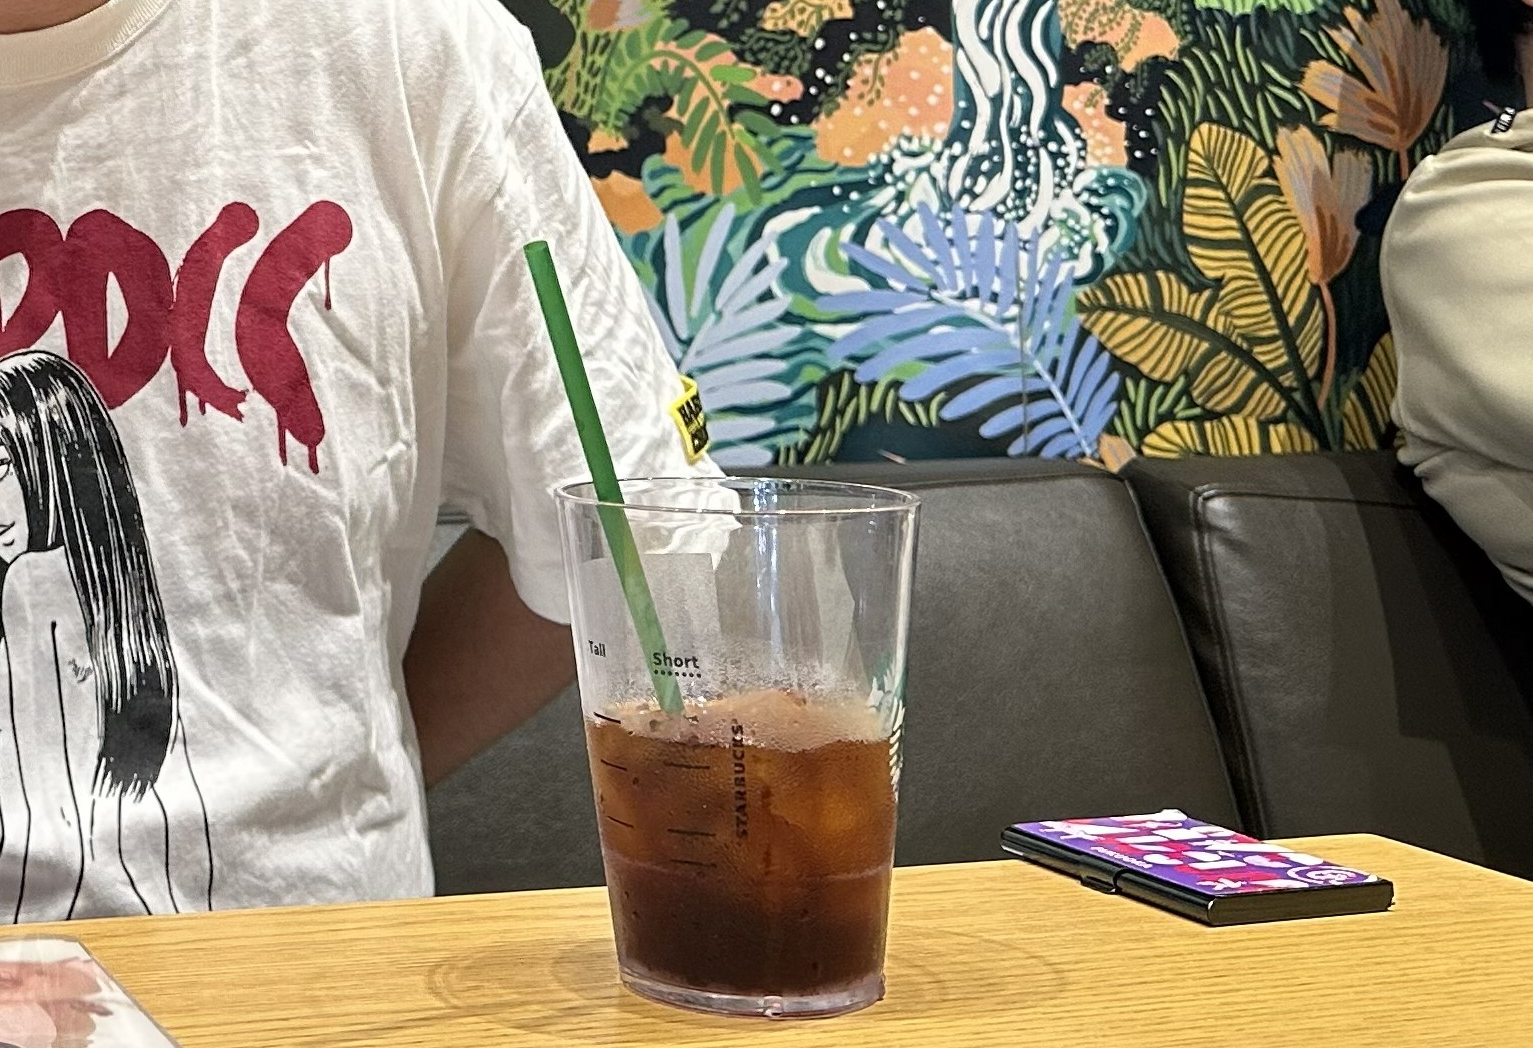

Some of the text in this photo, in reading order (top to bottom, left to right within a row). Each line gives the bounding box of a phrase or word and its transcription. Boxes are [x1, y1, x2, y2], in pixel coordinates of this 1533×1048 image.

[588, 640, 606, 657] Tall
[653, 652, 700, 669] Short
[731, 724, 749, 839] STARBUCKS
